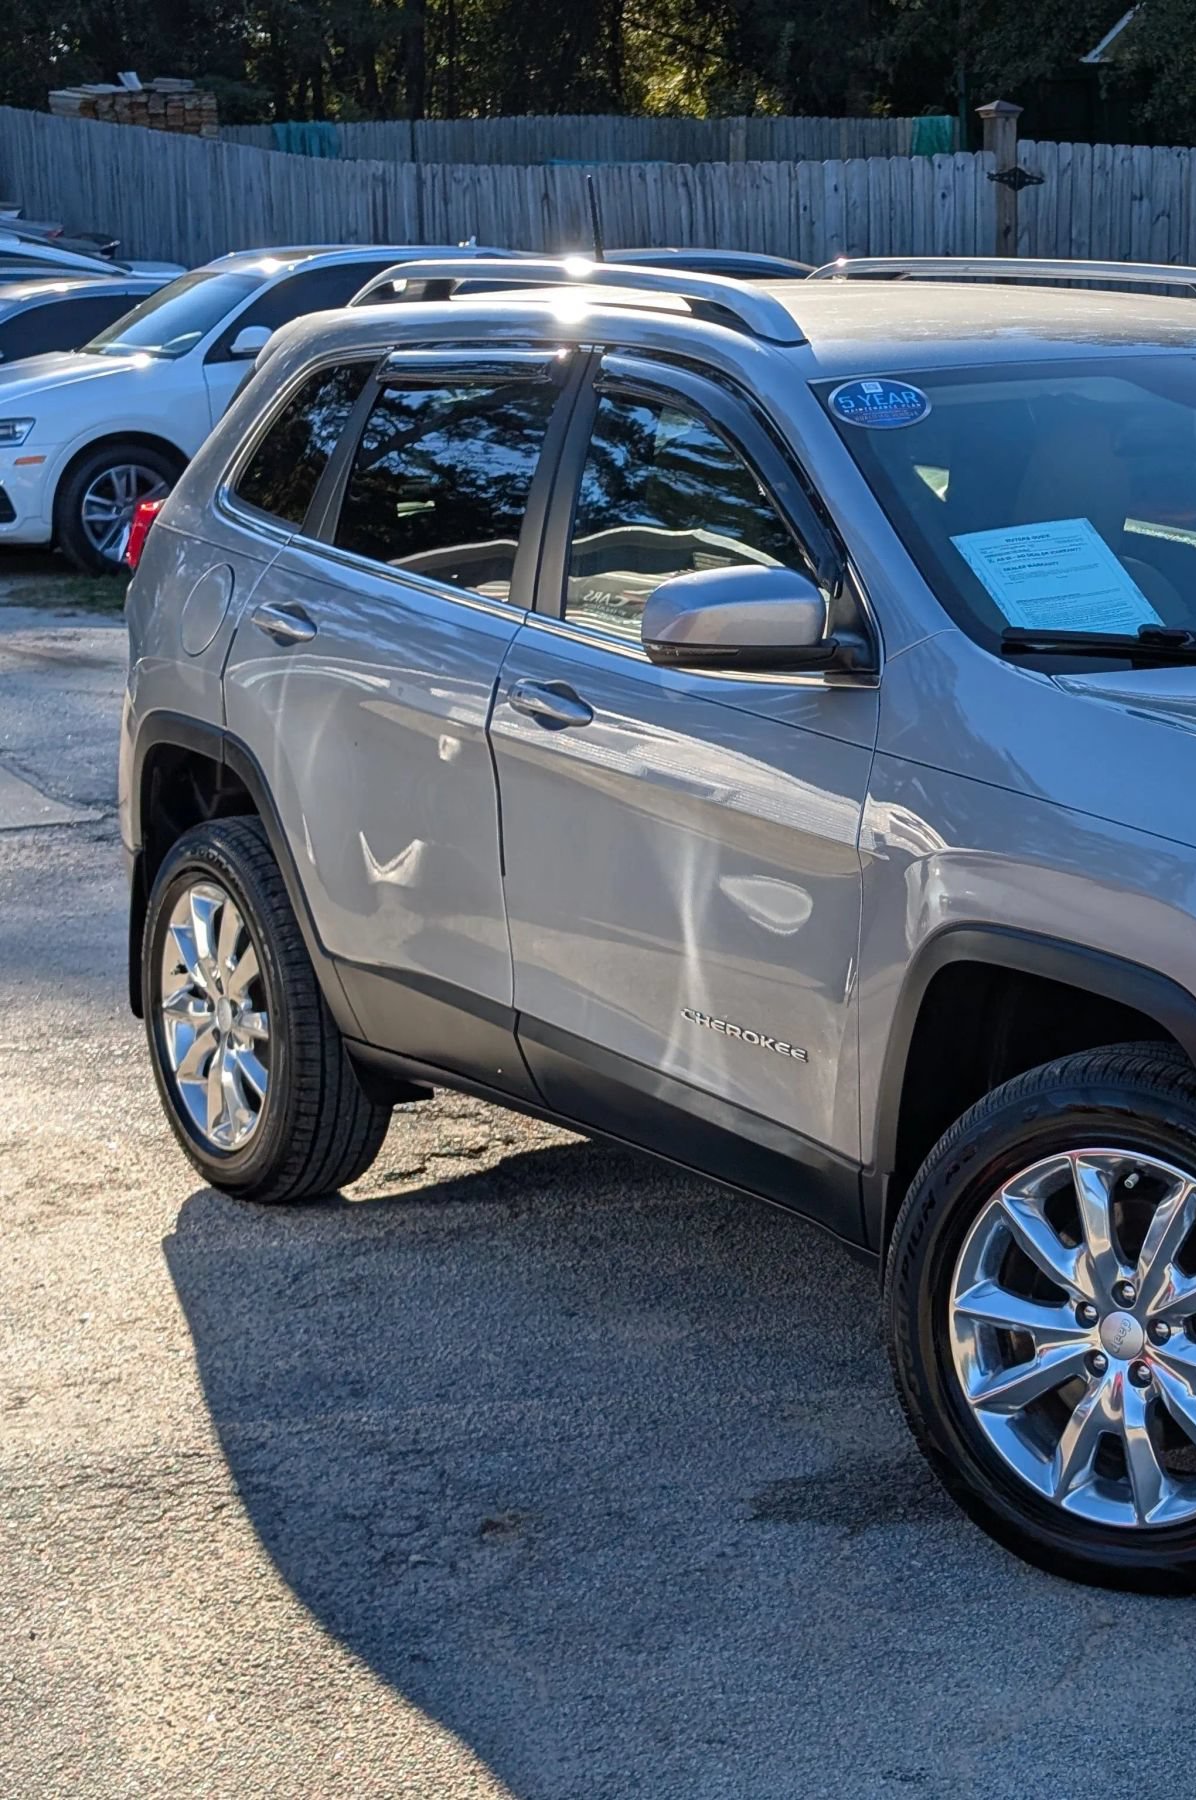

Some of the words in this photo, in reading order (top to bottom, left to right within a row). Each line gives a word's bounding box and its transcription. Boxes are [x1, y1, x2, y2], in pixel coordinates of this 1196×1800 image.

[838, 395, 855, 410] 5
[857, 392, 919, 407] YEAR
[680, 1007, 809, 1063] CHEROKEE
[1111, 1319, 1131, 1354] Jeep
